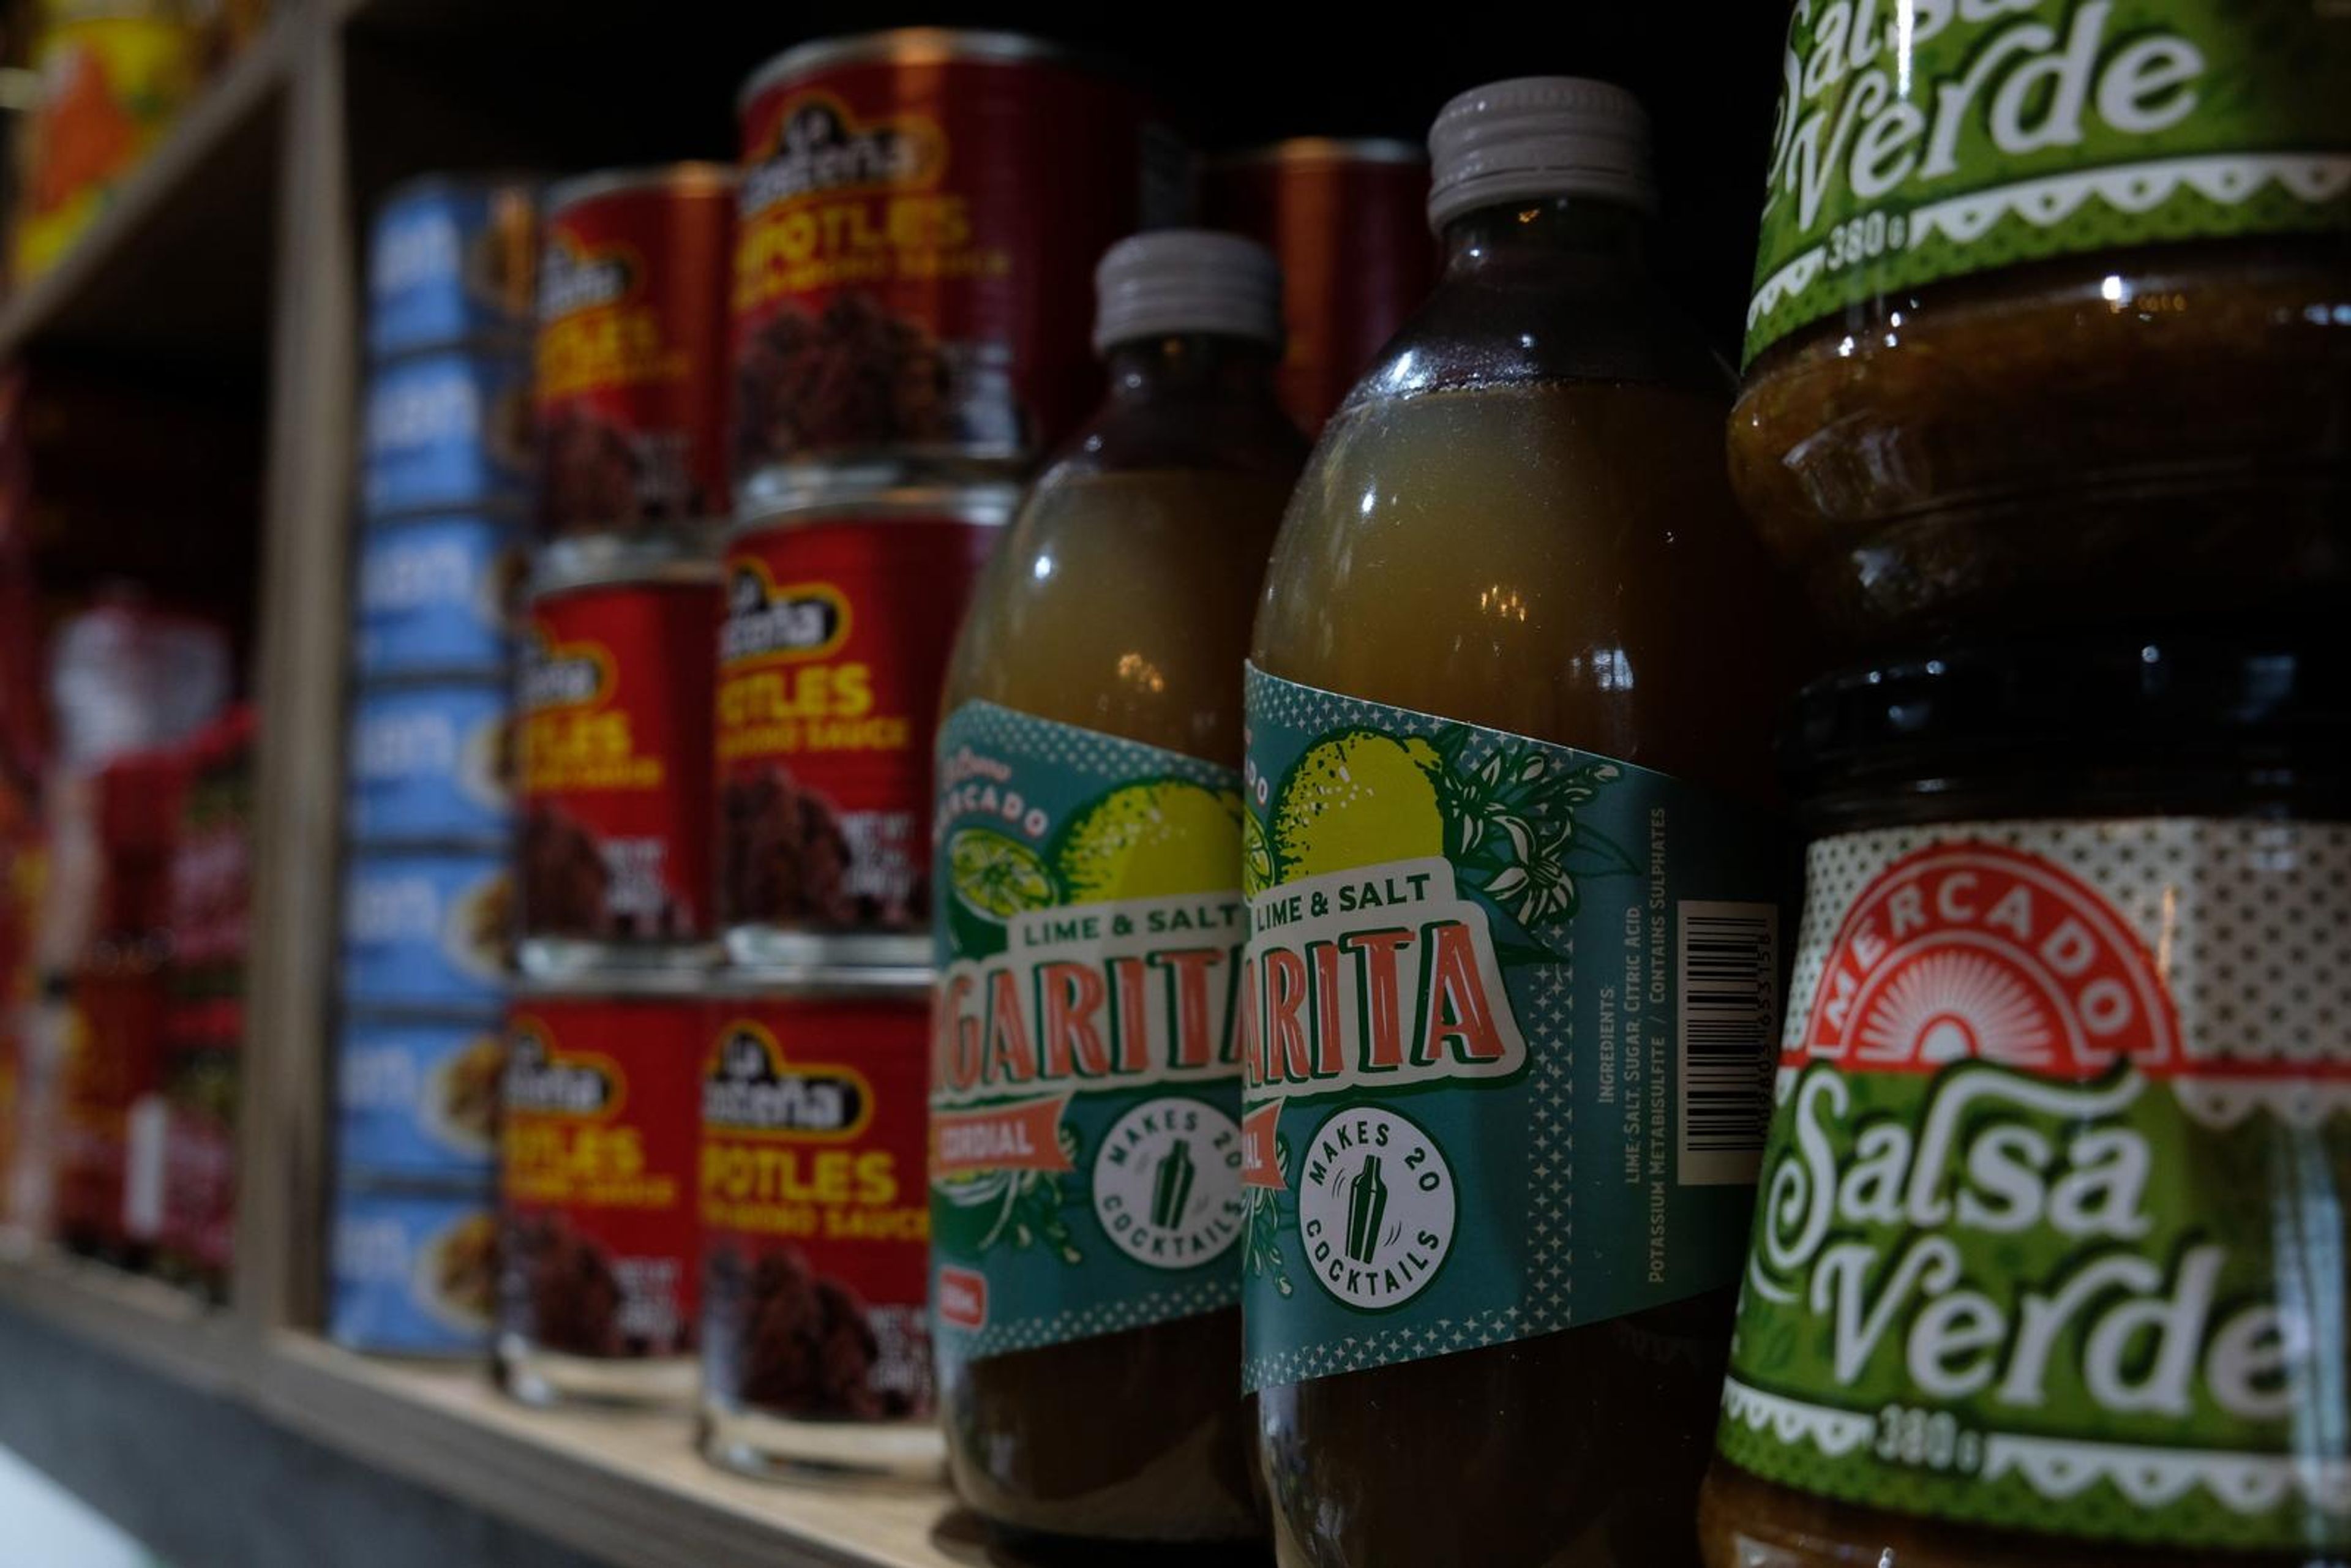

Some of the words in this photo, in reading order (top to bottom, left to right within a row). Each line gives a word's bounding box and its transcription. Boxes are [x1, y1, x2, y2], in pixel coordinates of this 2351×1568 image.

[1785, 0, 2205, 233] Verde
[1649, 807, 1667, 910] SULPHATES
[1024, 916, 1100, 947] LIME
[1111, 914, 1134, 936] &
[1147, 903, 1240, 932] SALT
[1256, 896, 1303, 932] LIME
[1310, 891, 1329, 917] &
[1338, 872, 1431, 913] SALT
[1624, 955, 1642, 1012] CITRIC
[1649, 915, 1667, 1003] CONTAINS
[1825, 869, 2134, 1038] MERCADO
[1649, 1015, 1666, 1026] /
[1109, 1108, 1199, 1168] MAKES
[1213, 1130, 1242, 1168] 20
[1649, 1037, 1666, 1175] METABISULFITE
[1308, 1120, 1390, 1186] MAKES
[1403, 1146, 1441, 1192] 20
[1766, 1068, 2155, 1272] Salsa
[1104, 1195, 1242, 1258] COCKTAILS
[1306, 1218, 1440, 1296] COCKTAILS
[1648, 1180, 1666, 1283] POTASSIUM
[1810, 1233, 2311, 1420] Verde
